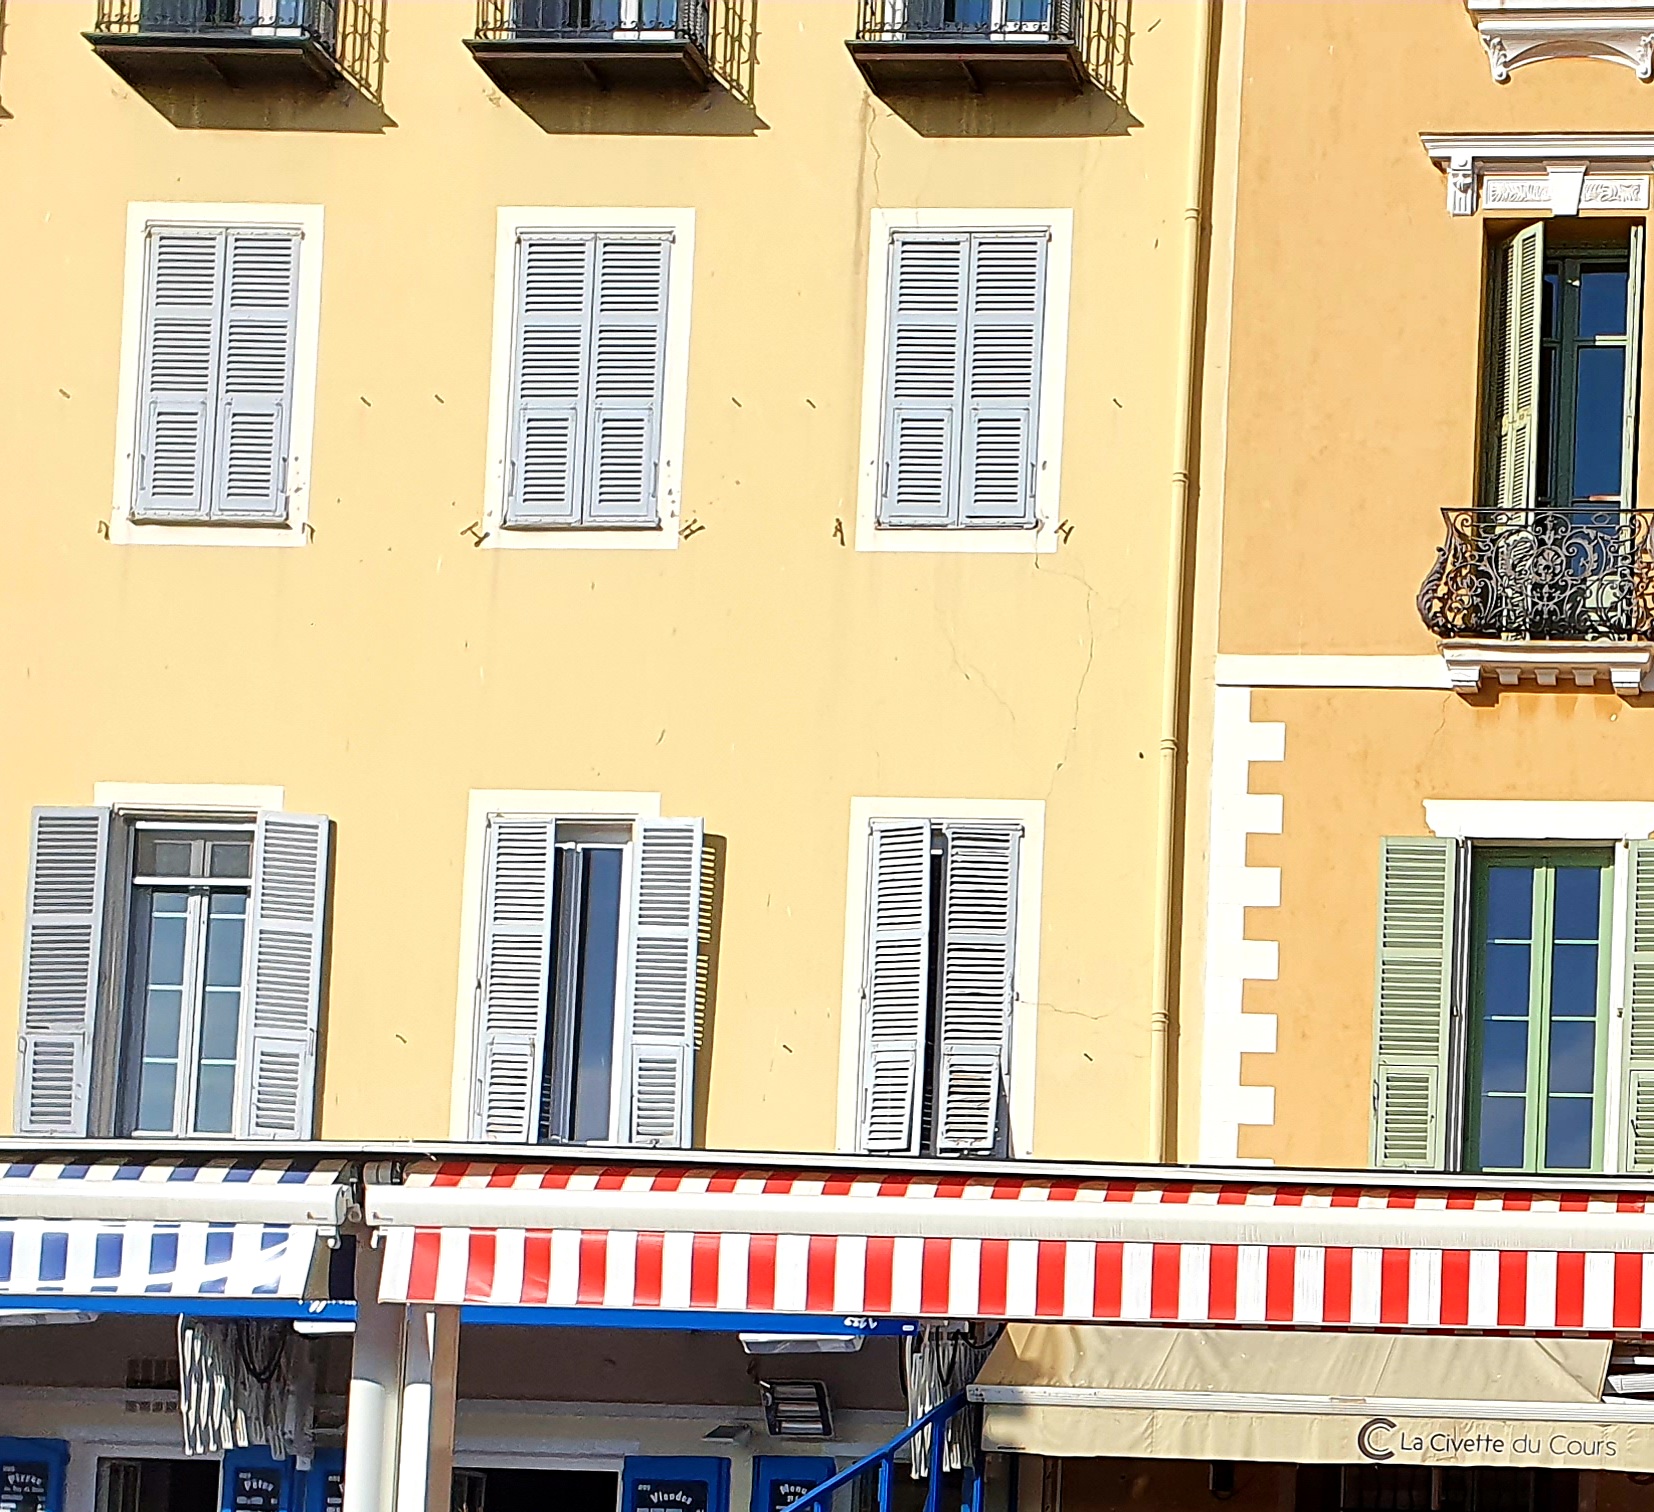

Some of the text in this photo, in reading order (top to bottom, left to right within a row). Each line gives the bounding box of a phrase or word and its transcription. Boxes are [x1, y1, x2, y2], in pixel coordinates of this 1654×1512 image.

[1401, 1432, 1424, 1451] La
[1430, 1433, 1504, 1453] Civette
[1513, 1434, 1541, 1453] du
[1550, 1435, 1617, 1456] Cours
